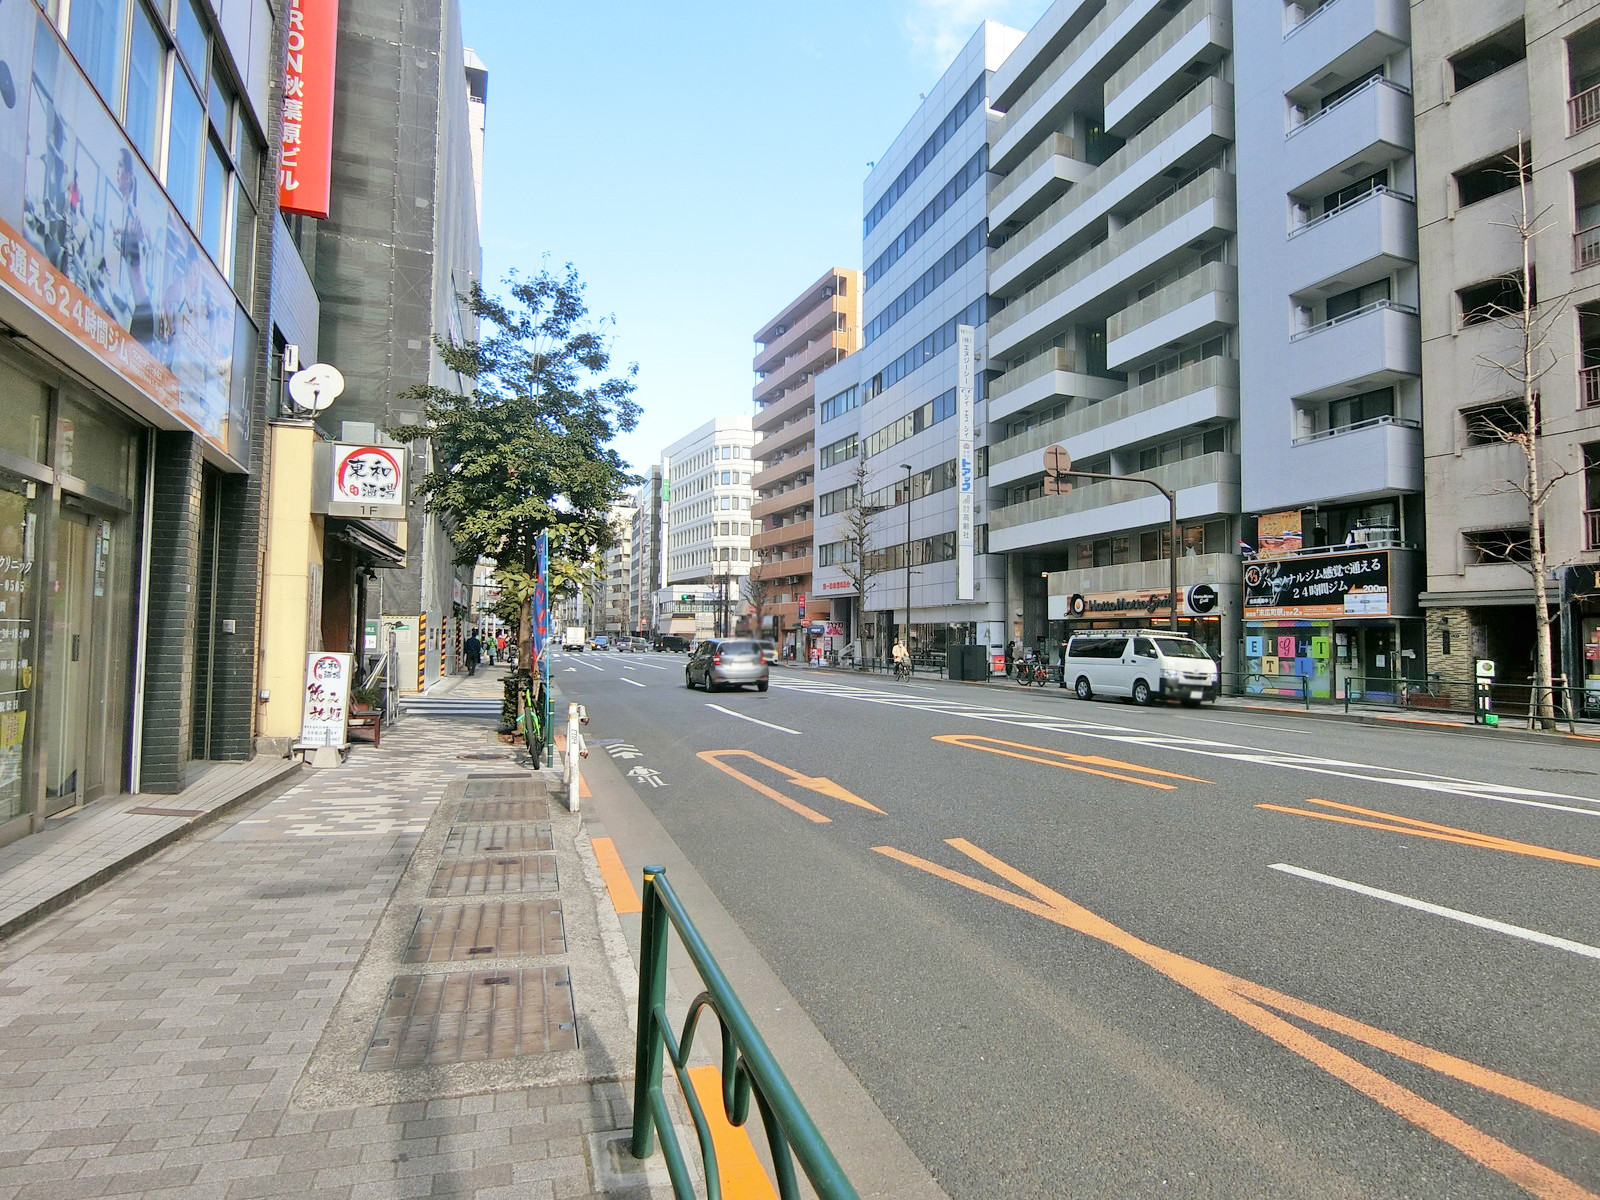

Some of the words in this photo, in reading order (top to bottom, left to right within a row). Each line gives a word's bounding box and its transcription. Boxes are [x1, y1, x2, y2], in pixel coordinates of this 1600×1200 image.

[348, 459, 393, 478] 東和
[362, 482, 397, 499] 酒場
[360, 506, 378, 515] 1F
[1262, 558, 1381, 588] パソナルジム感覚で通える
[1362, 584, 1388, 594] 200m
[1251, 638, 1327, 656] EIGHT
